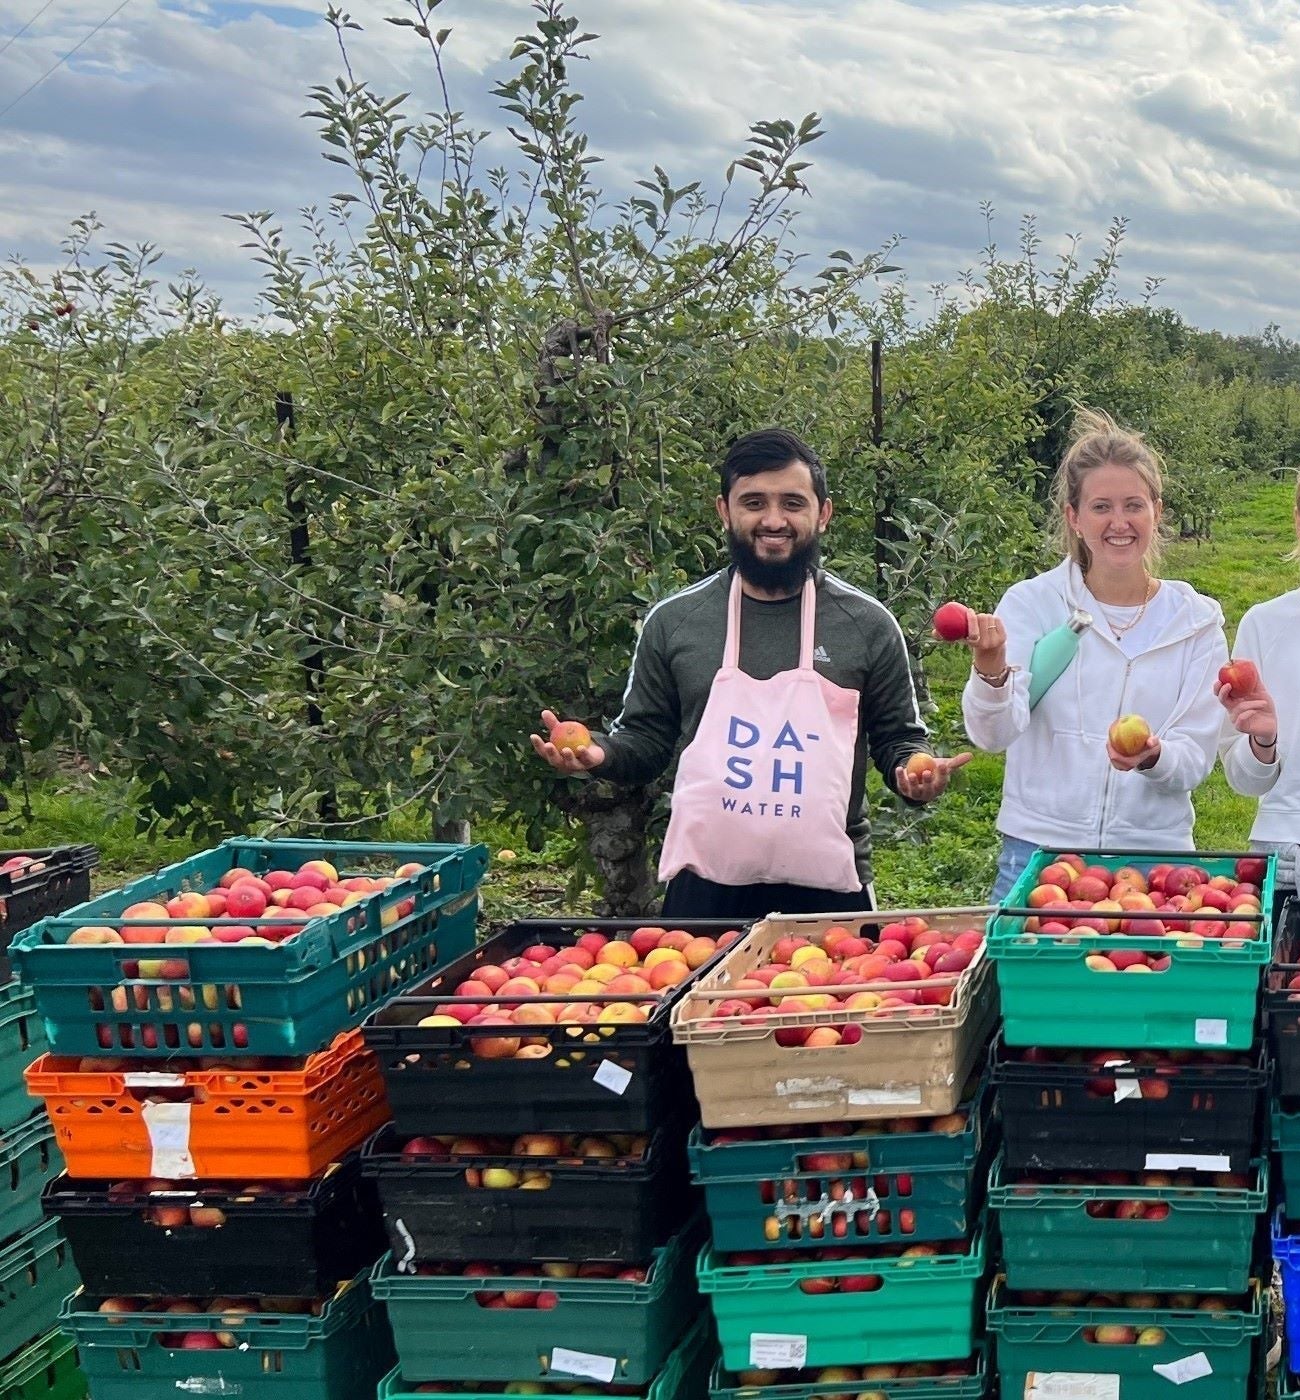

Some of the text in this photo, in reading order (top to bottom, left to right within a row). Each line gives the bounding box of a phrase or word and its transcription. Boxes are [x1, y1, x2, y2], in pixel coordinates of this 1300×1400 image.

[728, 715, 820, 752] DA-
[724, 756, 803, 794] SH
[722, 797, 801, 818] WATER
